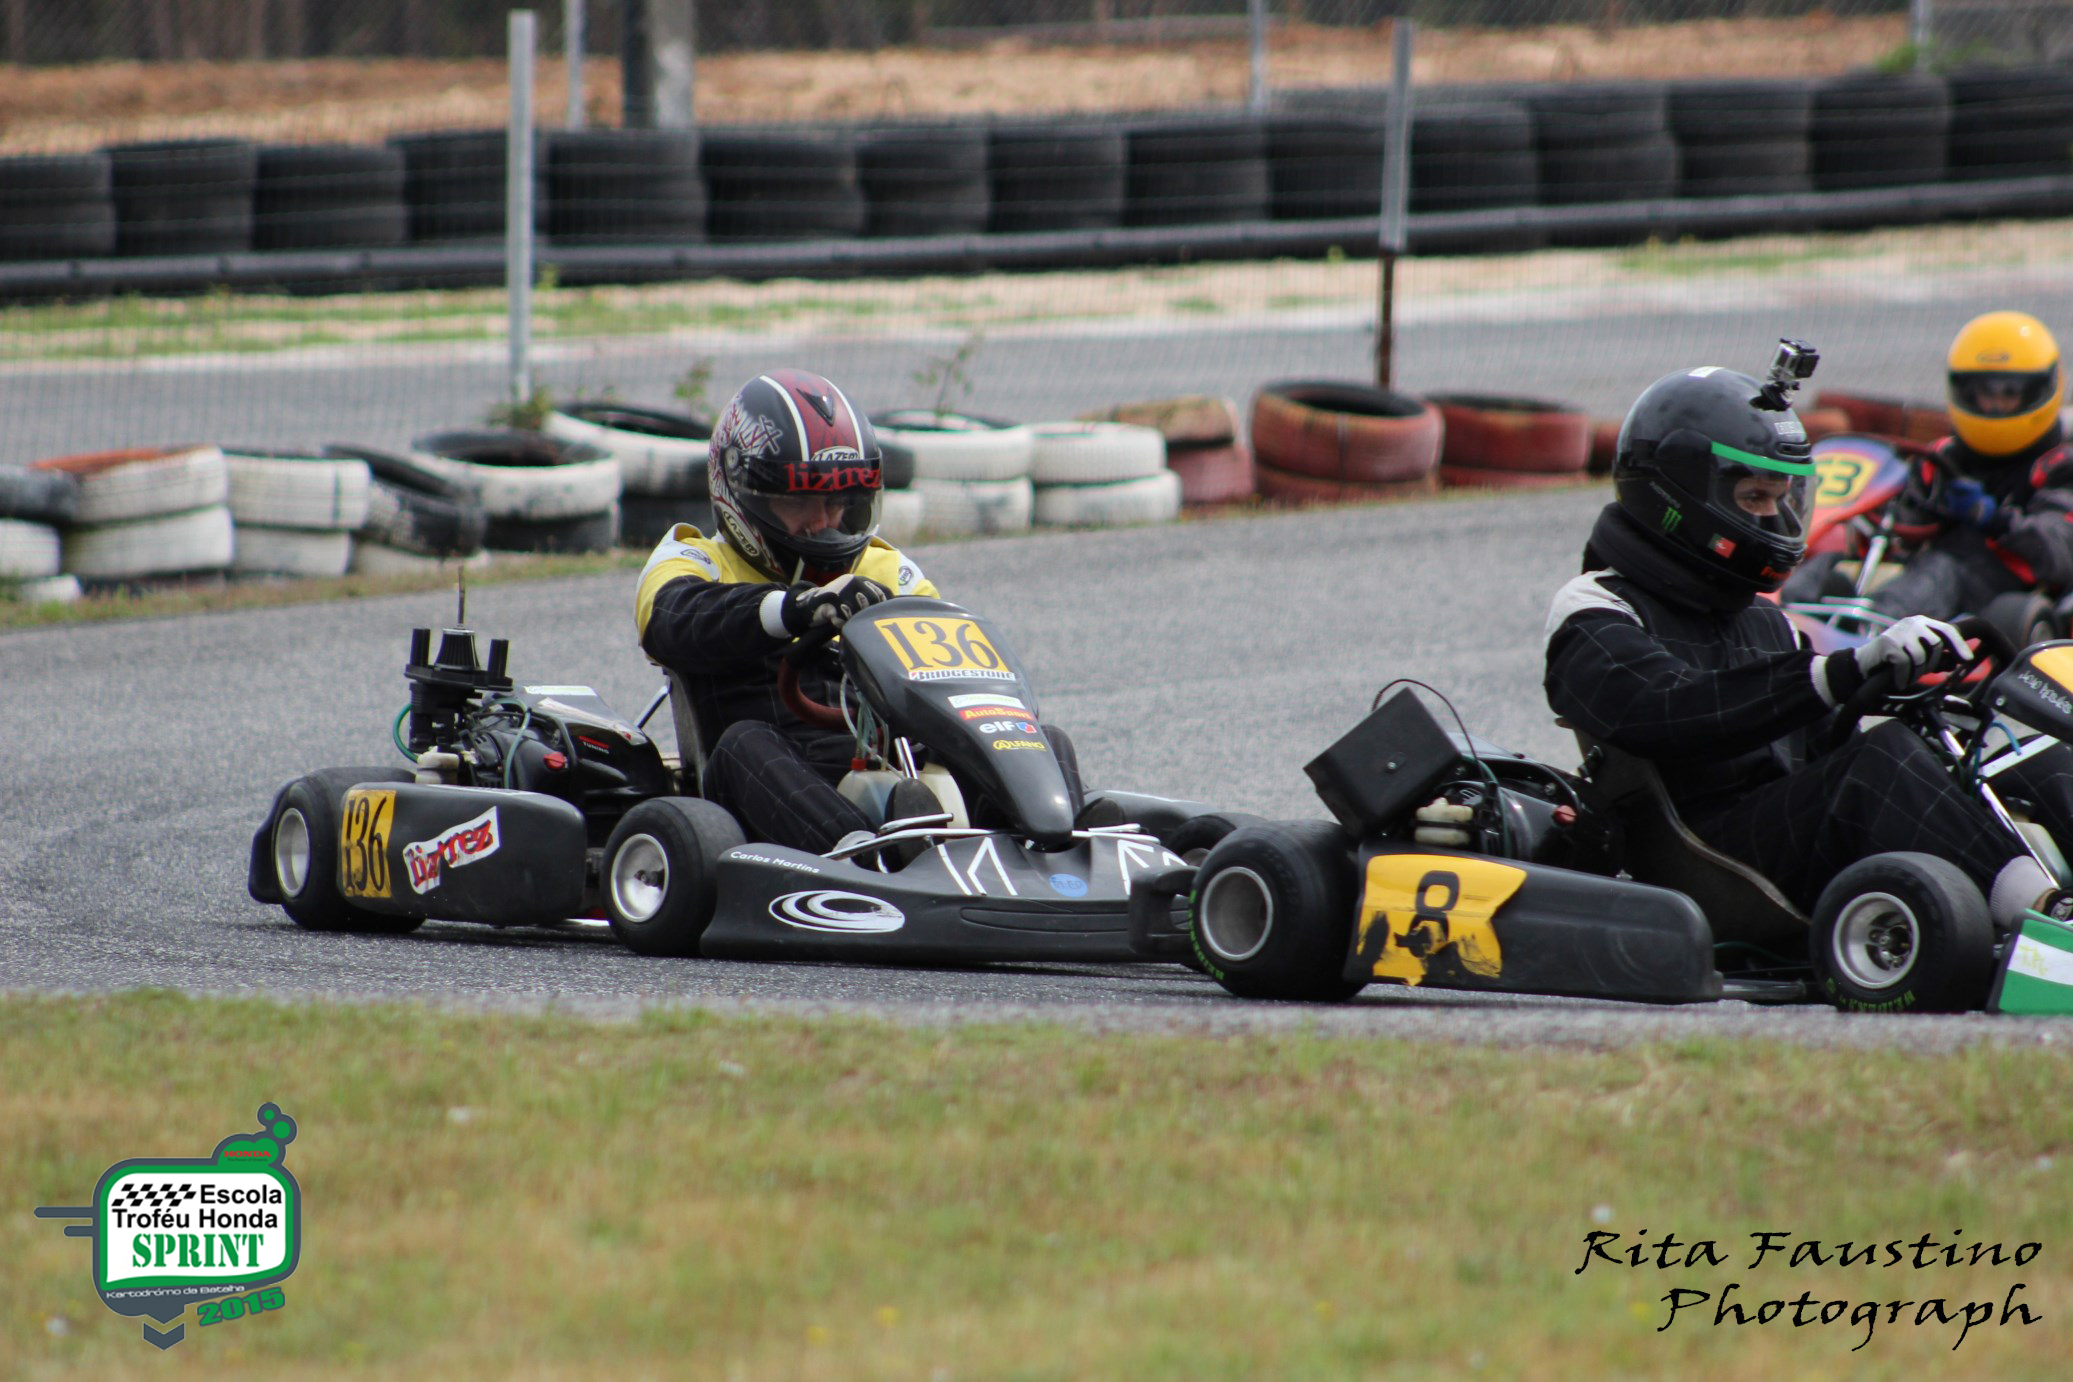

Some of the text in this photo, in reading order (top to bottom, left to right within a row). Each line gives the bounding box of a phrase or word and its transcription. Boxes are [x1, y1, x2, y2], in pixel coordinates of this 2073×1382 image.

[882, 621, 1000, 669] 136
[911, 669, 1014, 681] BRIDGESTONE
[979, 721, 1015, 734] elf
[345, 797, 387, 891] 136
[730, 851, 819, 874] Carlos Martins
